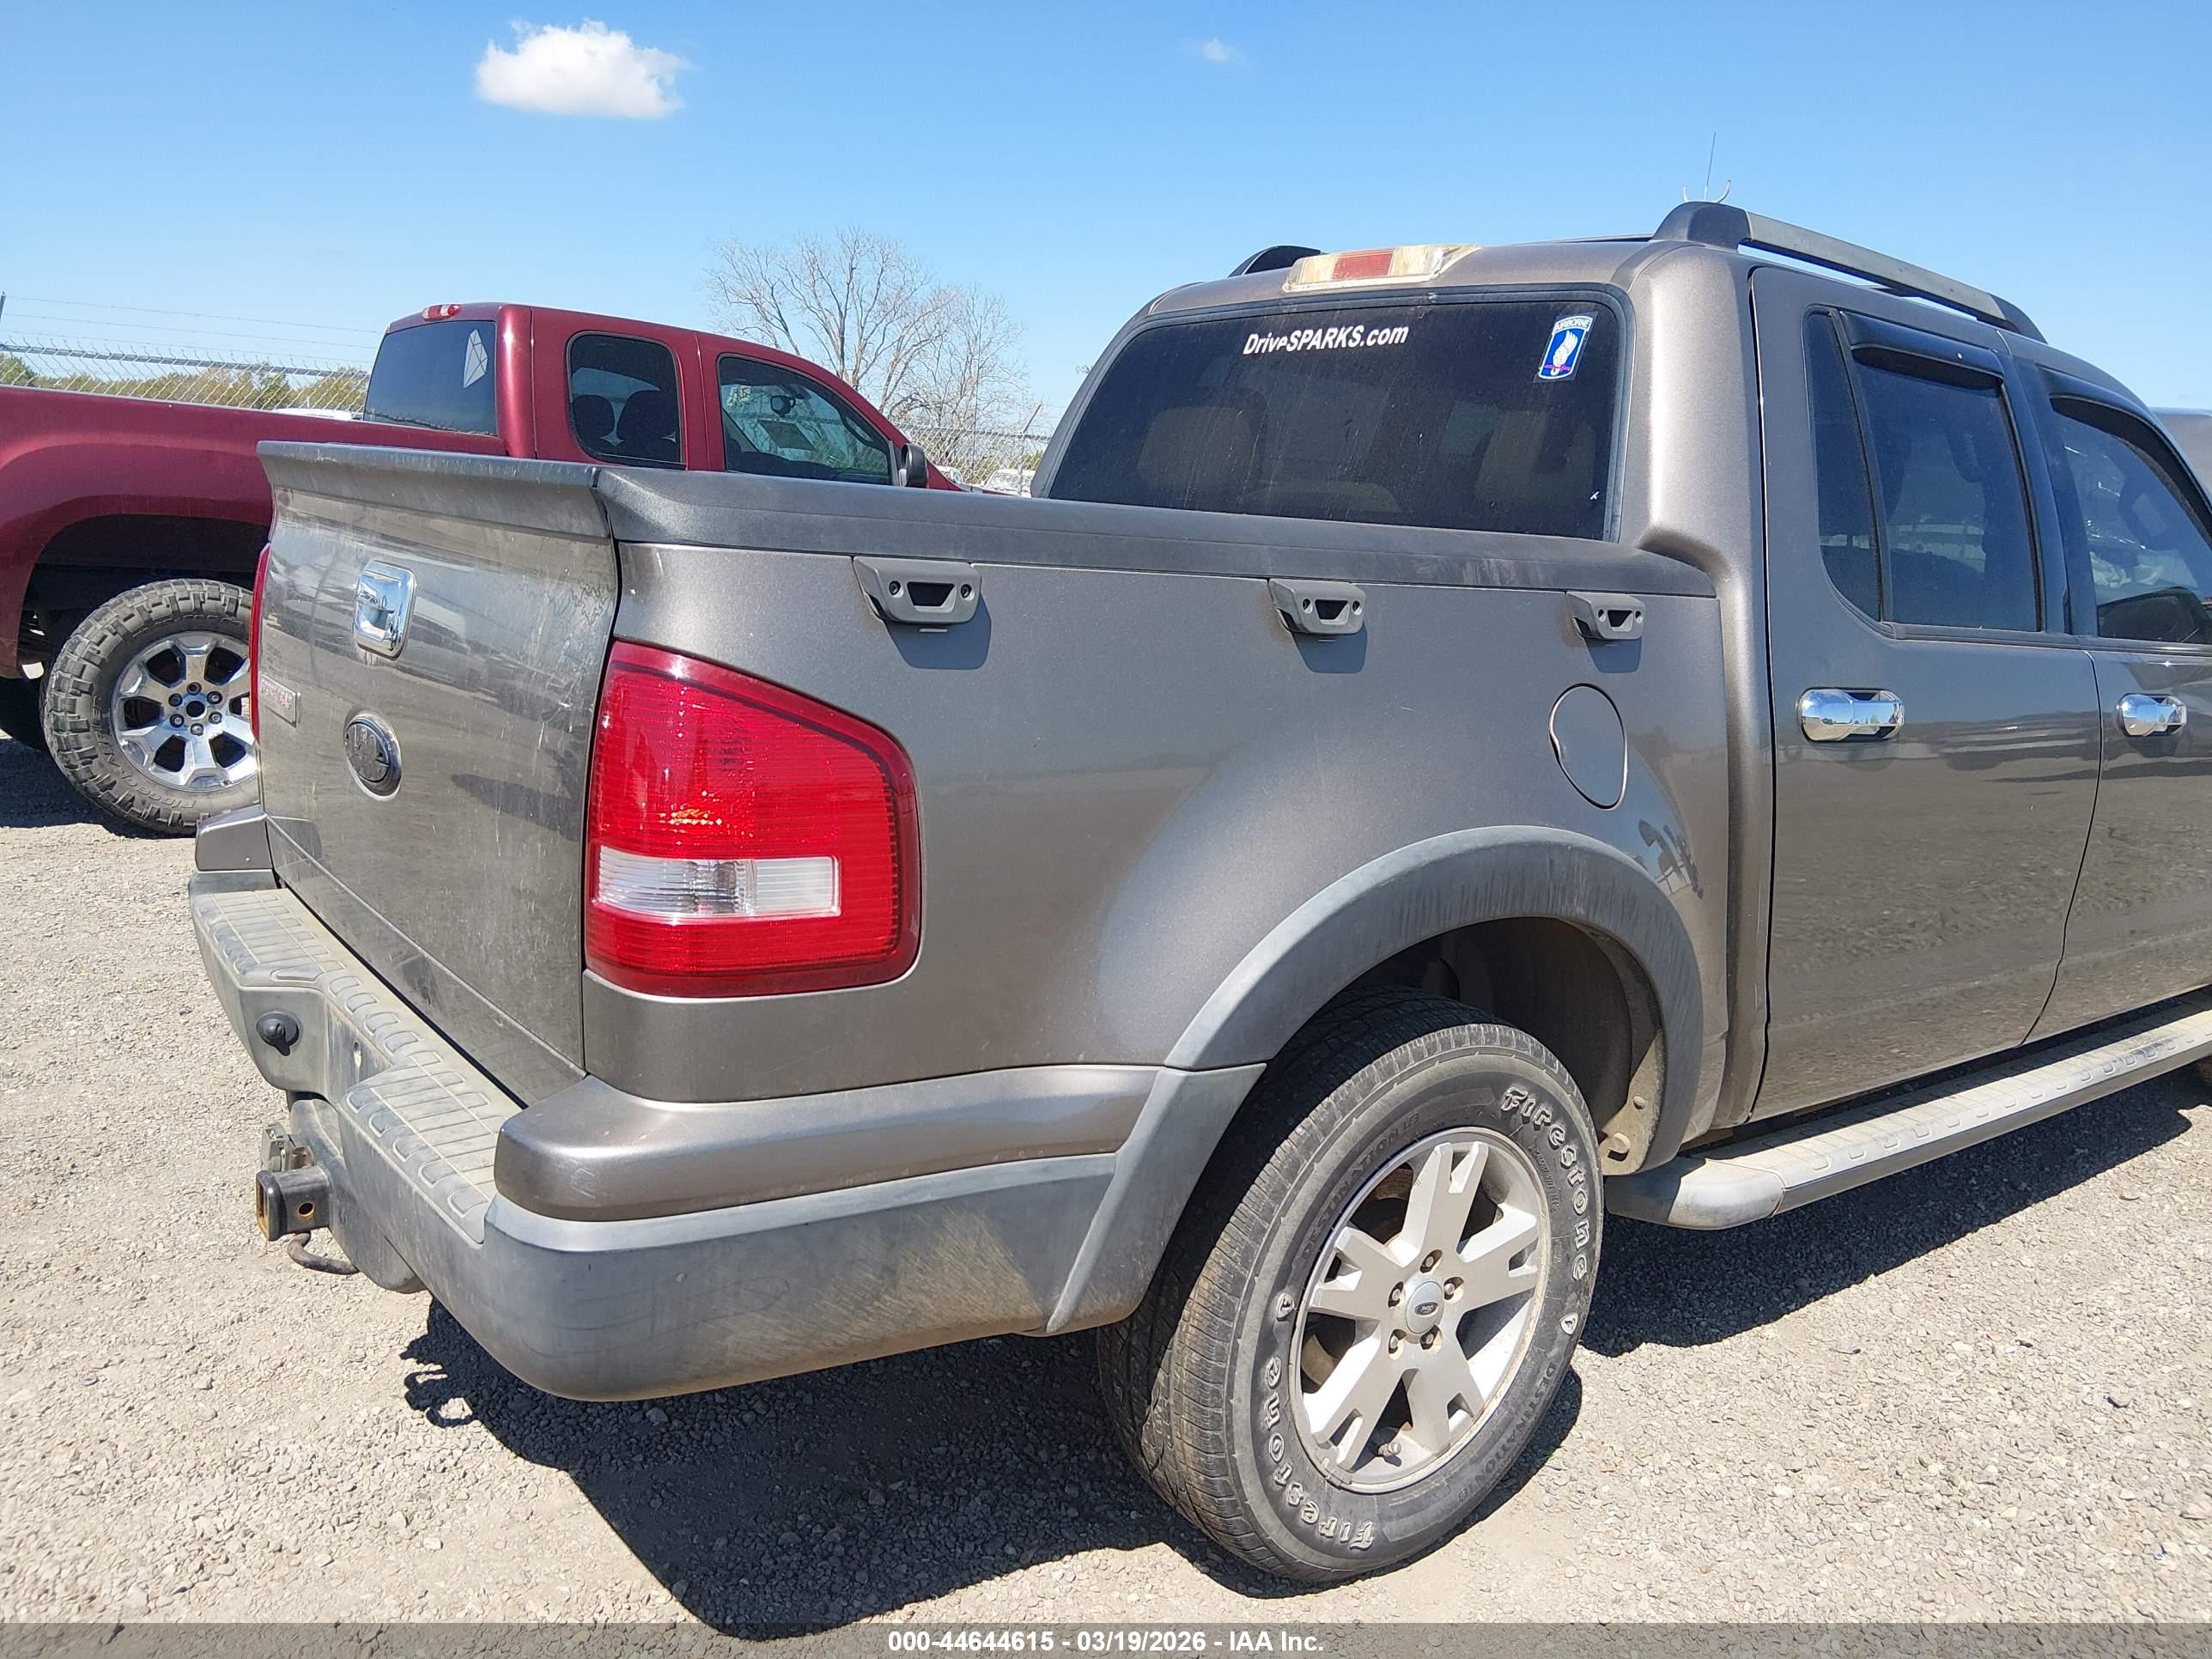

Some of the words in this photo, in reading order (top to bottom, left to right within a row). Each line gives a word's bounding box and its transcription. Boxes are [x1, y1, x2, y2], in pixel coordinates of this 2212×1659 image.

[1243, 325, 1410, 355] DriveSPARKS.com
[1552, 319, 1590, 332] AIRBORNE
[1500, 1086, 1589, 1282] Firestone
[1264, 1355, 1375, 1550] Firestone
